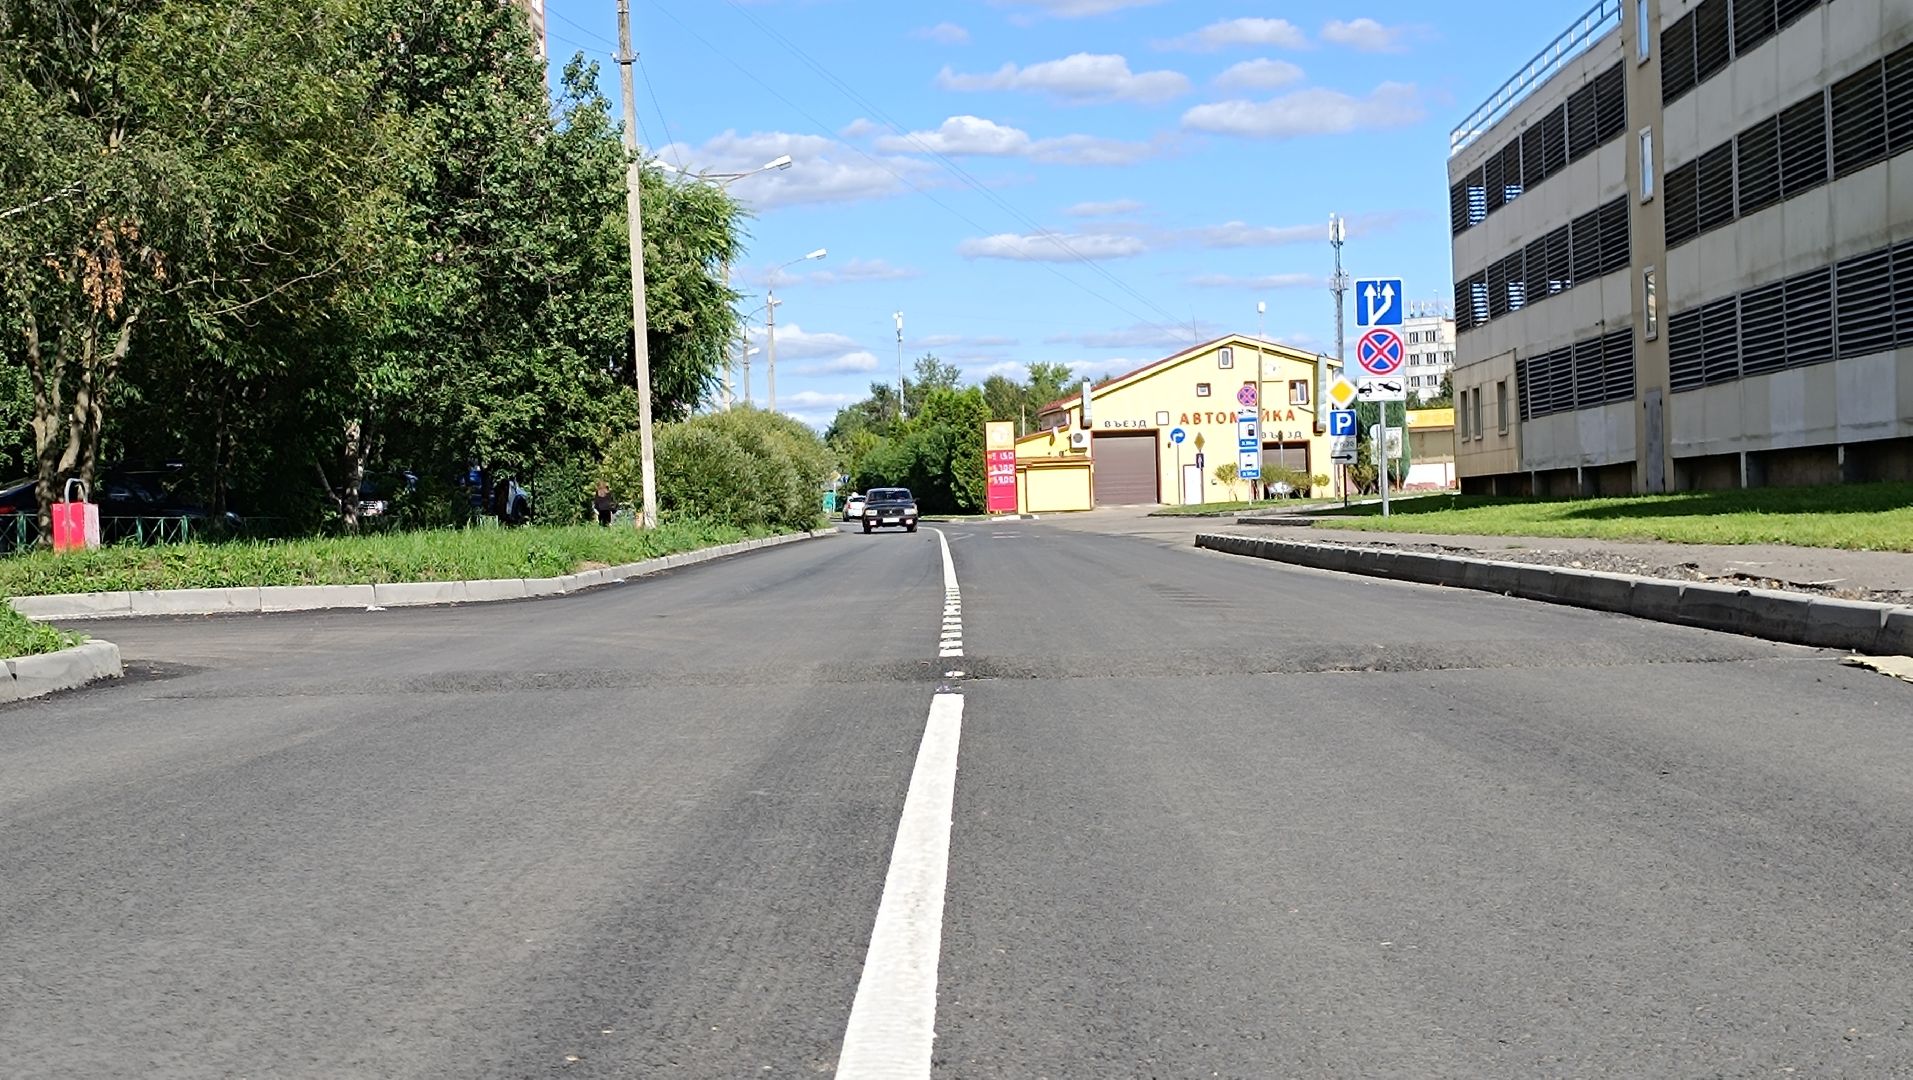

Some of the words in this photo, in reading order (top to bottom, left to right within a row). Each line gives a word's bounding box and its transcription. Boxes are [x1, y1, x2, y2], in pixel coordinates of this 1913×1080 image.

[1180, 408, 1295, 425] АВТОМЙКА
[1104, 420, 1147, 428] ВЪЕЗД
[1336, 413, 1352, 435] P
[1261, 430, 1303, 439] ВЪЗД
